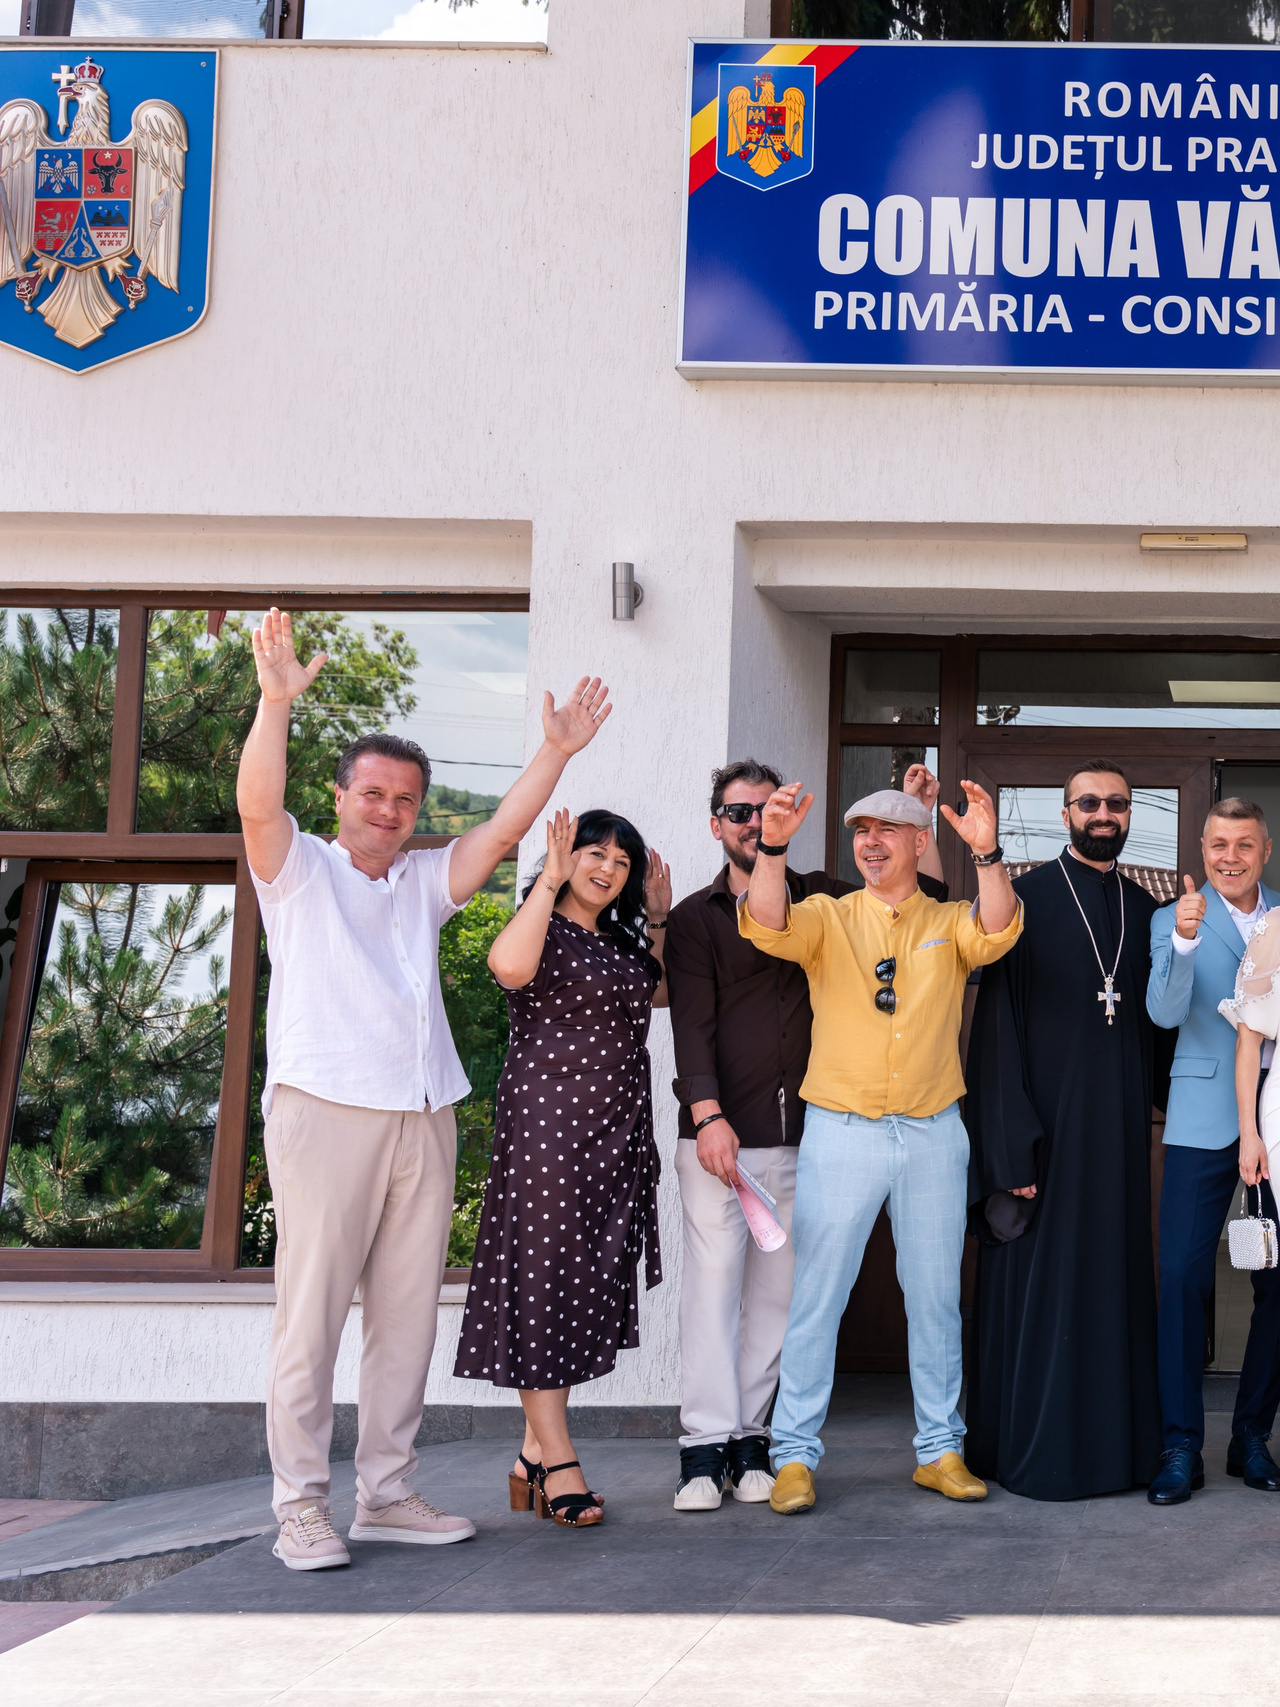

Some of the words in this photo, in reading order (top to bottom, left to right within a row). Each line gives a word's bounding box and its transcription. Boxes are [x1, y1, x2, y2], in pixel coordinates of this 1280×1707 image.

[971, 134, 1173, 180] JUDEȚUL
[818, 193, 1160, 278] COMUNA
[814, 282, 1073, 333] PRIMĂRIA
